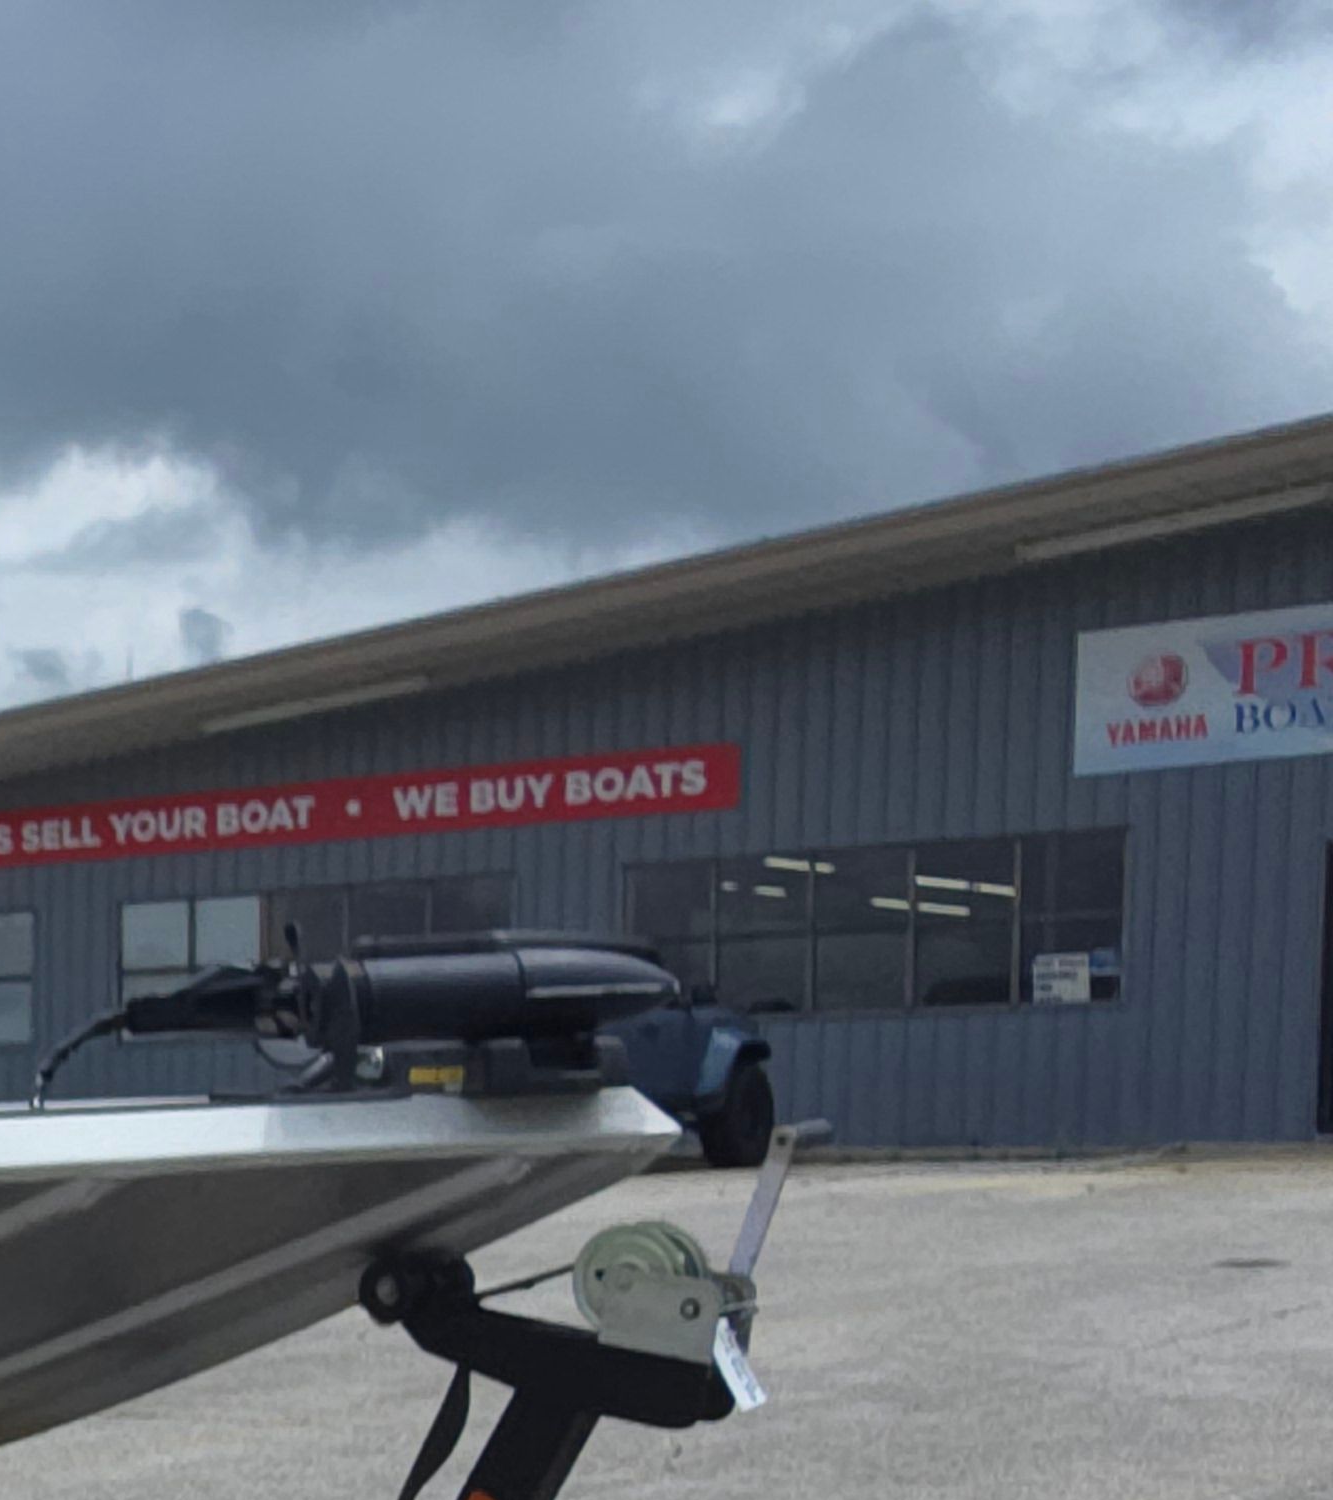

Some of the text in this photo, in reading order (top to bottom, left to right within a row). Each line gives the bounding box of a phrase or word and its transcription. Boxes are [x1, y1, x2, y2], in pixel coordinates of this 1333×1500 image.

[1106, 713, 1209, 748] YAMAHA
[22, 816, 101, 852] SELL
[109, 806, 206, 845] YOUR
[216, 796, 315, 836] BOAT
[393, 781, 459, 820] WE
[470, 773, 554, 815] BUY
[564, 760, 707, 806] BOATS
